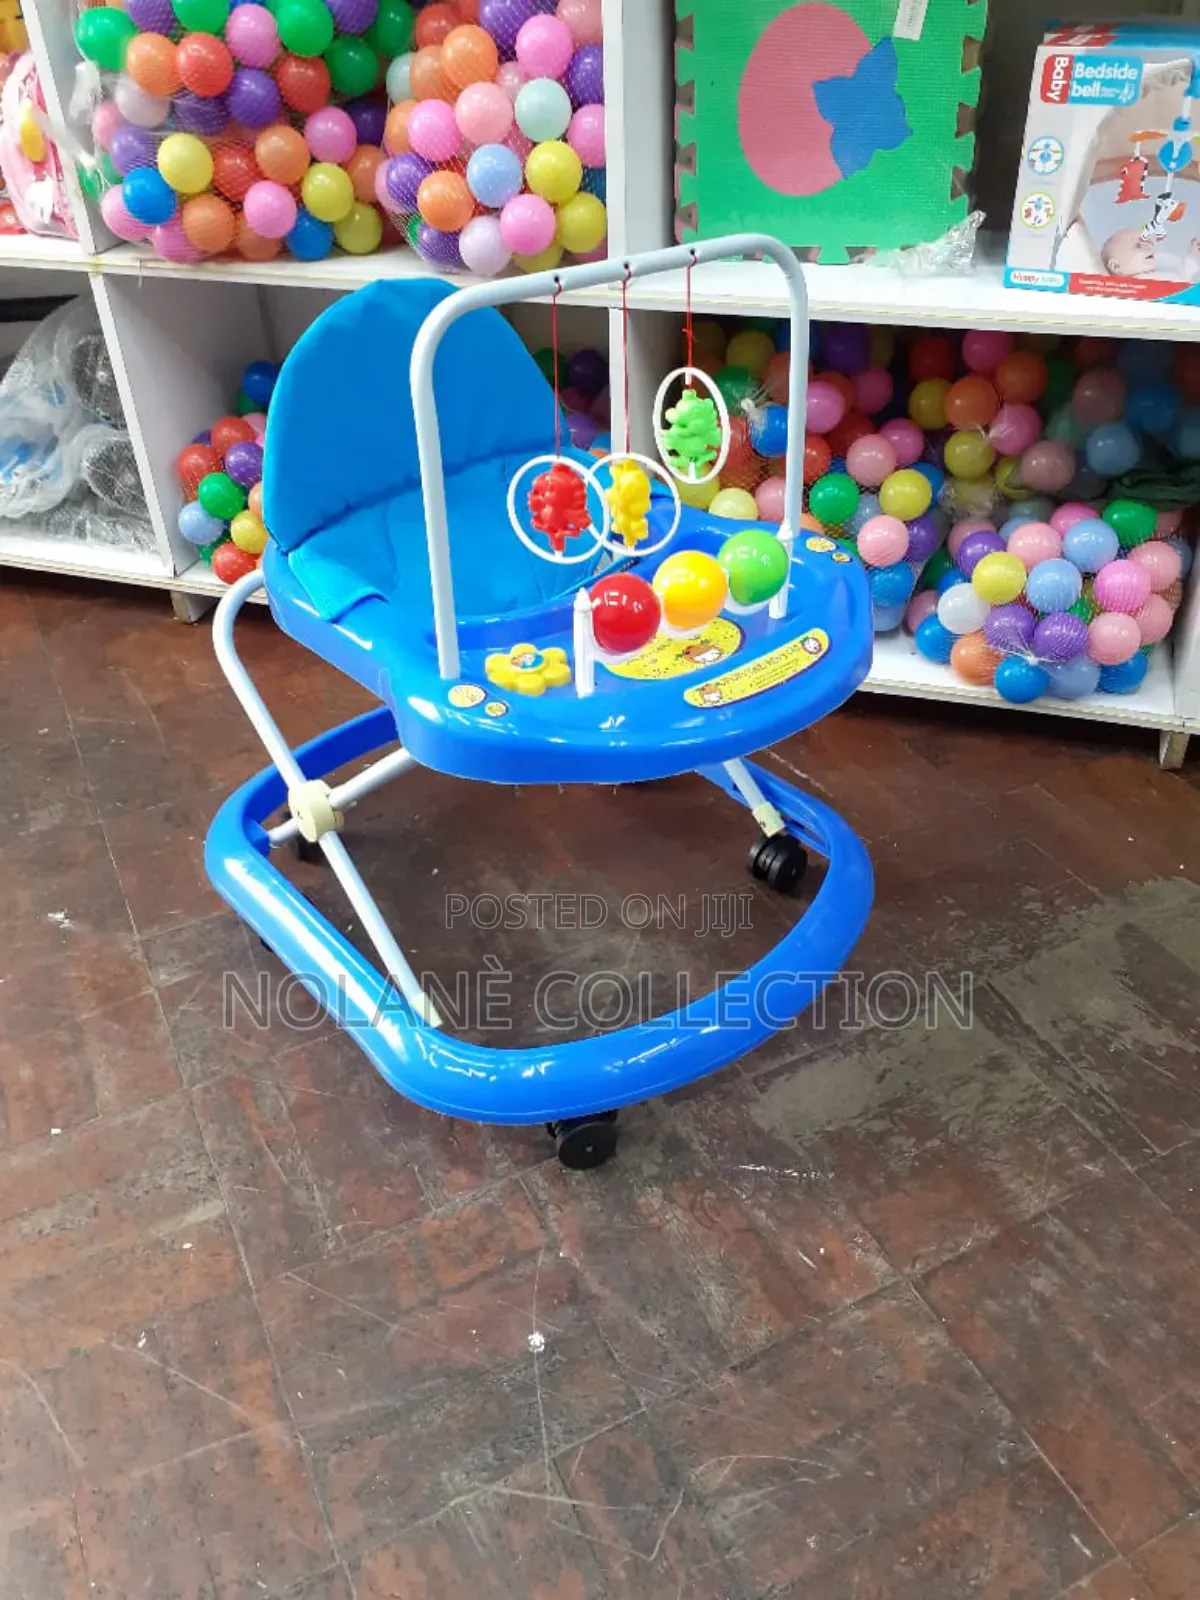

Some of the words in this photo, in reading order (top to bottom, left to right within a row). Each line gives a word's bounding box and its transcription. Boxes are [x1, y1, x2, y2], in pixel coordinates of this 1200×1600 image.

[1046, 57, 1069, 101] Baby
[1075, 62, 1138, 80] Bedside
[1071, 80, 1101, 97] bell
